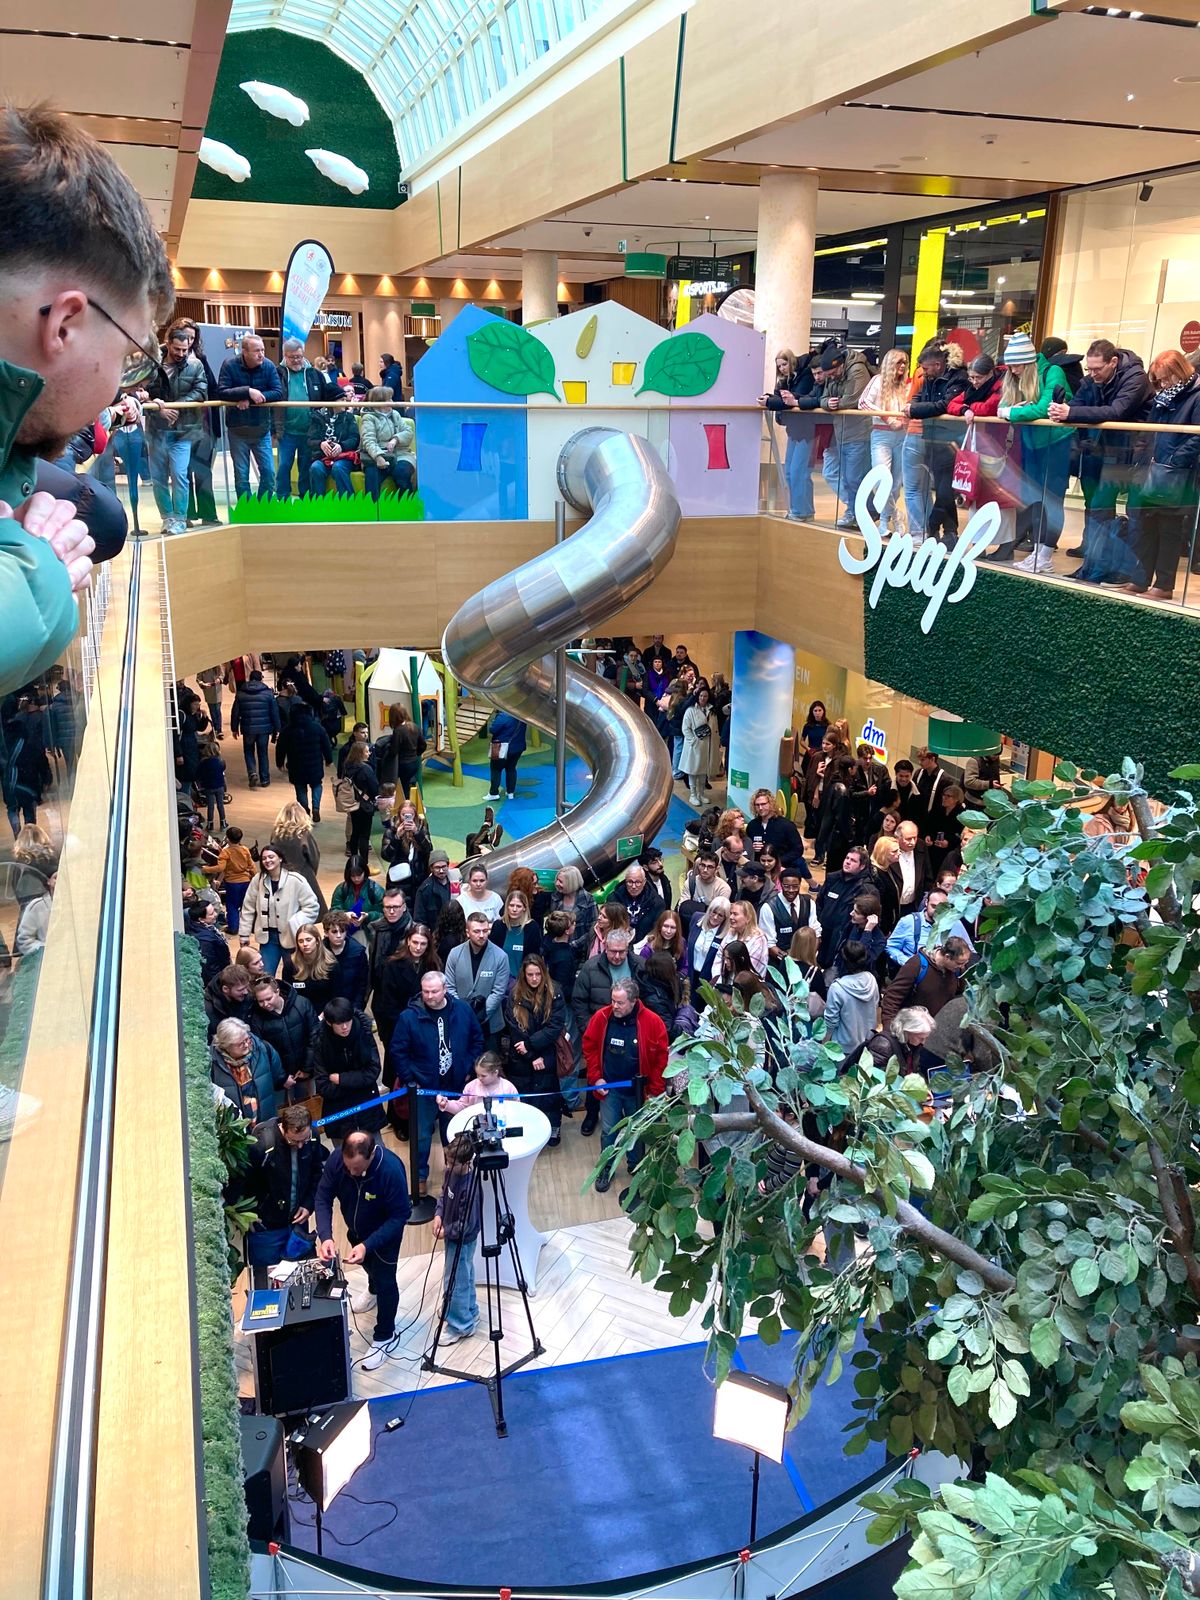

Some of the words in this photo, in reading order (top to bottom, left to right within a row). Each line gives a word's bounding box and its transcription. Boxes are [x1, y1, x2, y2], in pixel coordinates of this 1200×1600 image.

[838, 464, 1001, 634] Spaß
[863, 720, 885, 747] dm
[326, 1106, 361, 1121] HOLOGATE
